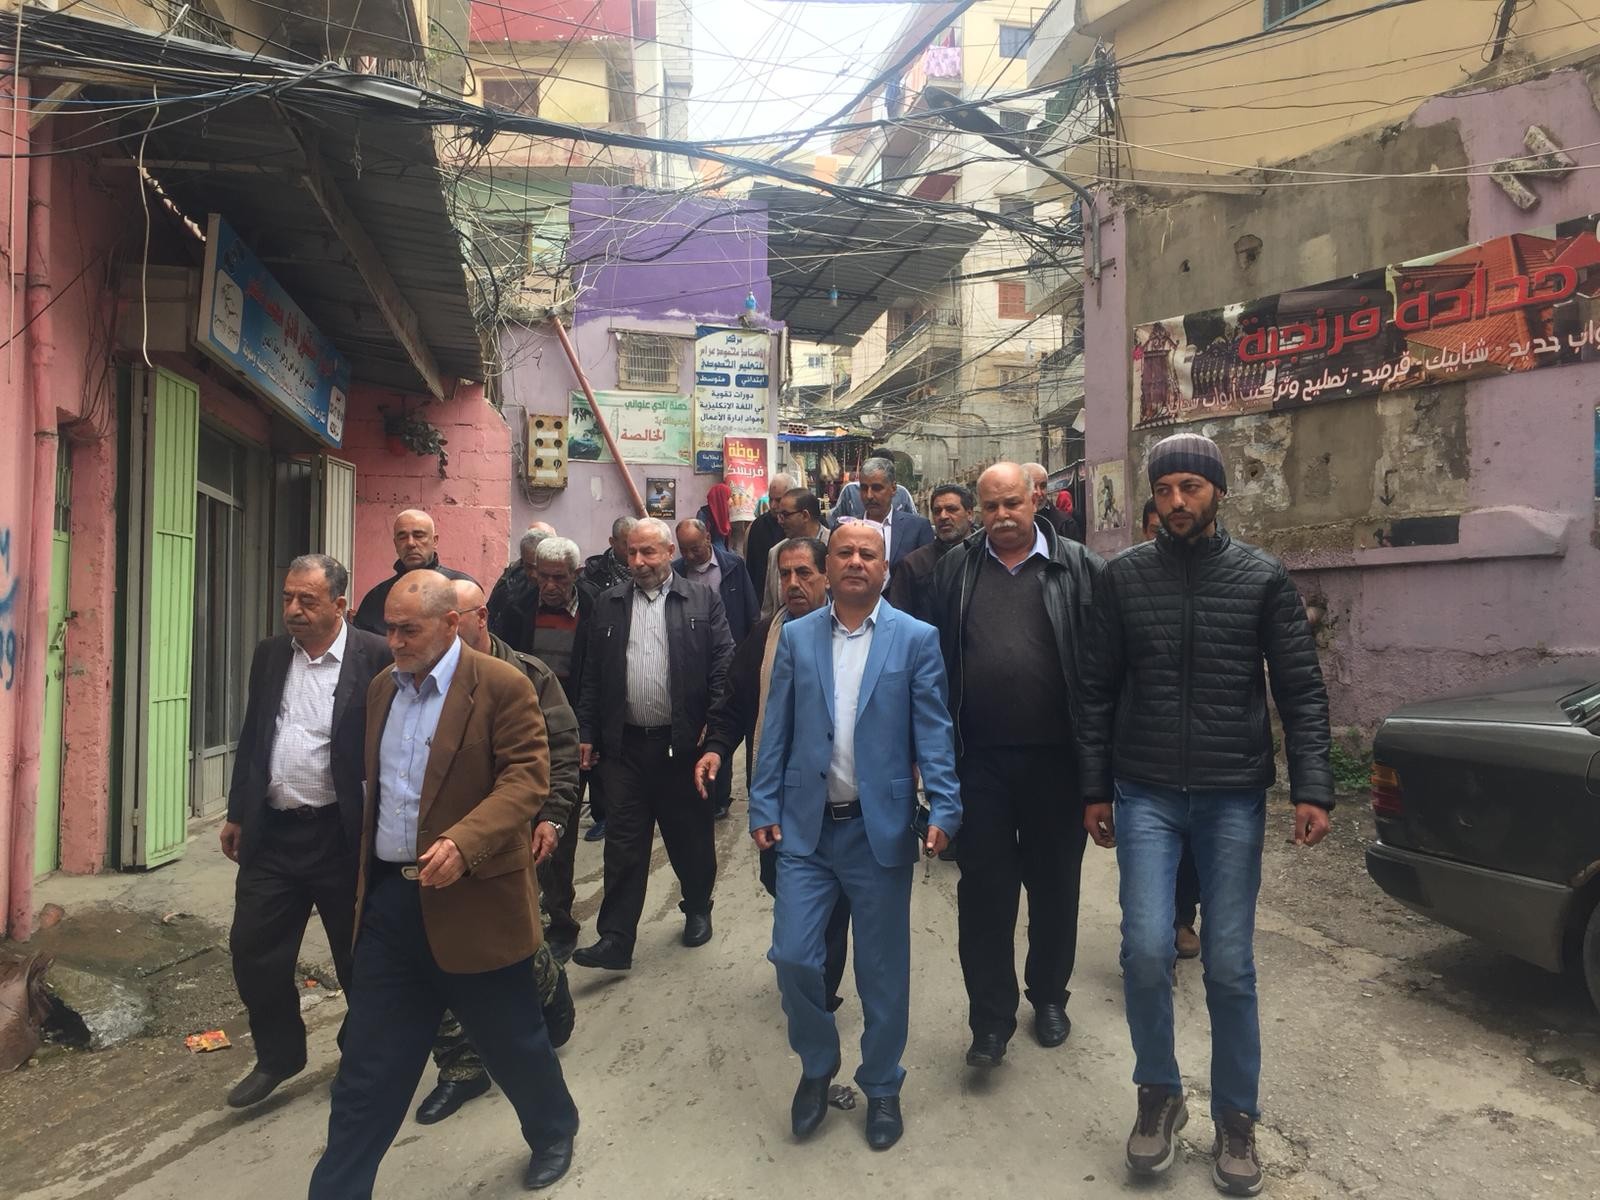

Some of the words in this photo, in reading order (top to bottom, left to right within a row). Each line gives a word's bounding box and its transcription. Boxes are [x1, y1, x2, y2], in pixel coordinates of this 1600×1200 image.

[1395, 263, 1579, 331] حدادة
[1238, 295, 1381, 368] فرنجية
[1425, 338, 1489, 372] شبابيك
[1509, 336, 1562, 359] حديد
[1360, 350, 1411, 386] قرميد
[699, 375, 725, 384] متوسط
[1302, 367, 1349, 402] تصليح
[711, 390, 732, 400] تقوية
[734, 391, 753, 400] دورات
[735, 402, 753, 412] اللغة
[754, 405, 765, 415] في
[745, 414, 765, 425] ومواد
[620, 428, 666, 444] الخالصة
[728, 440, 760, 461] بوظة
